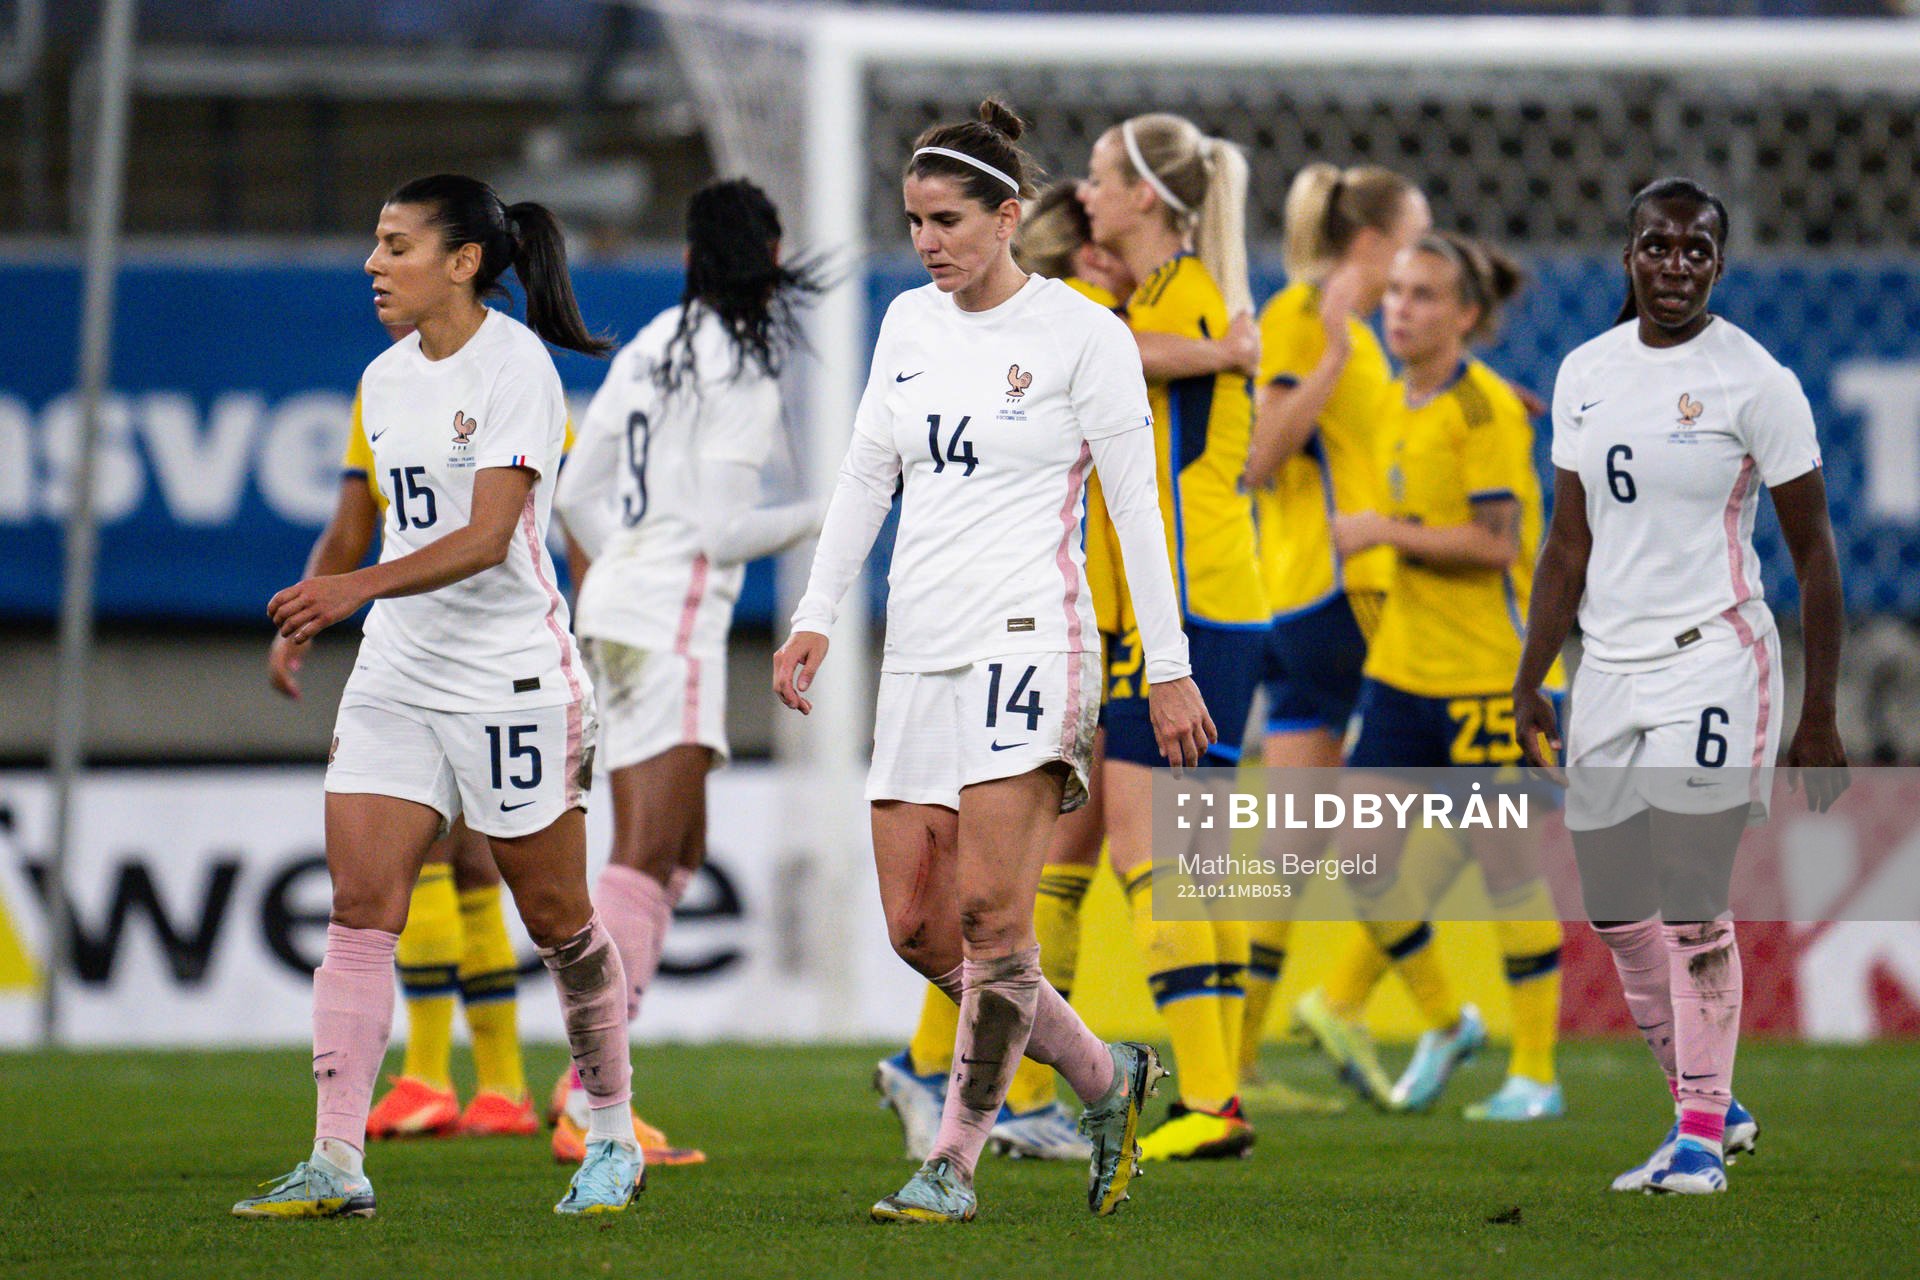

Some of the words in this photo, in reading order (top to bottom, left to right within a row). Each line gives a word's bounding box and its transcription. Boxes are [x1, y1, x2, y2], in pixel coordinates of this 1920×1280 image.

[623, 411, 648, 527] 9
[926, 413, 979, 477] 14
[1606, 444, 1637, 504] 6
[389, 465, 437, 532] 15
[985, 663, 1044, 731] 14
[484, 724, 543, 790] 15
[1448, 698, 1523, 764] 25
[1695, 706, 1729, 769] 6
